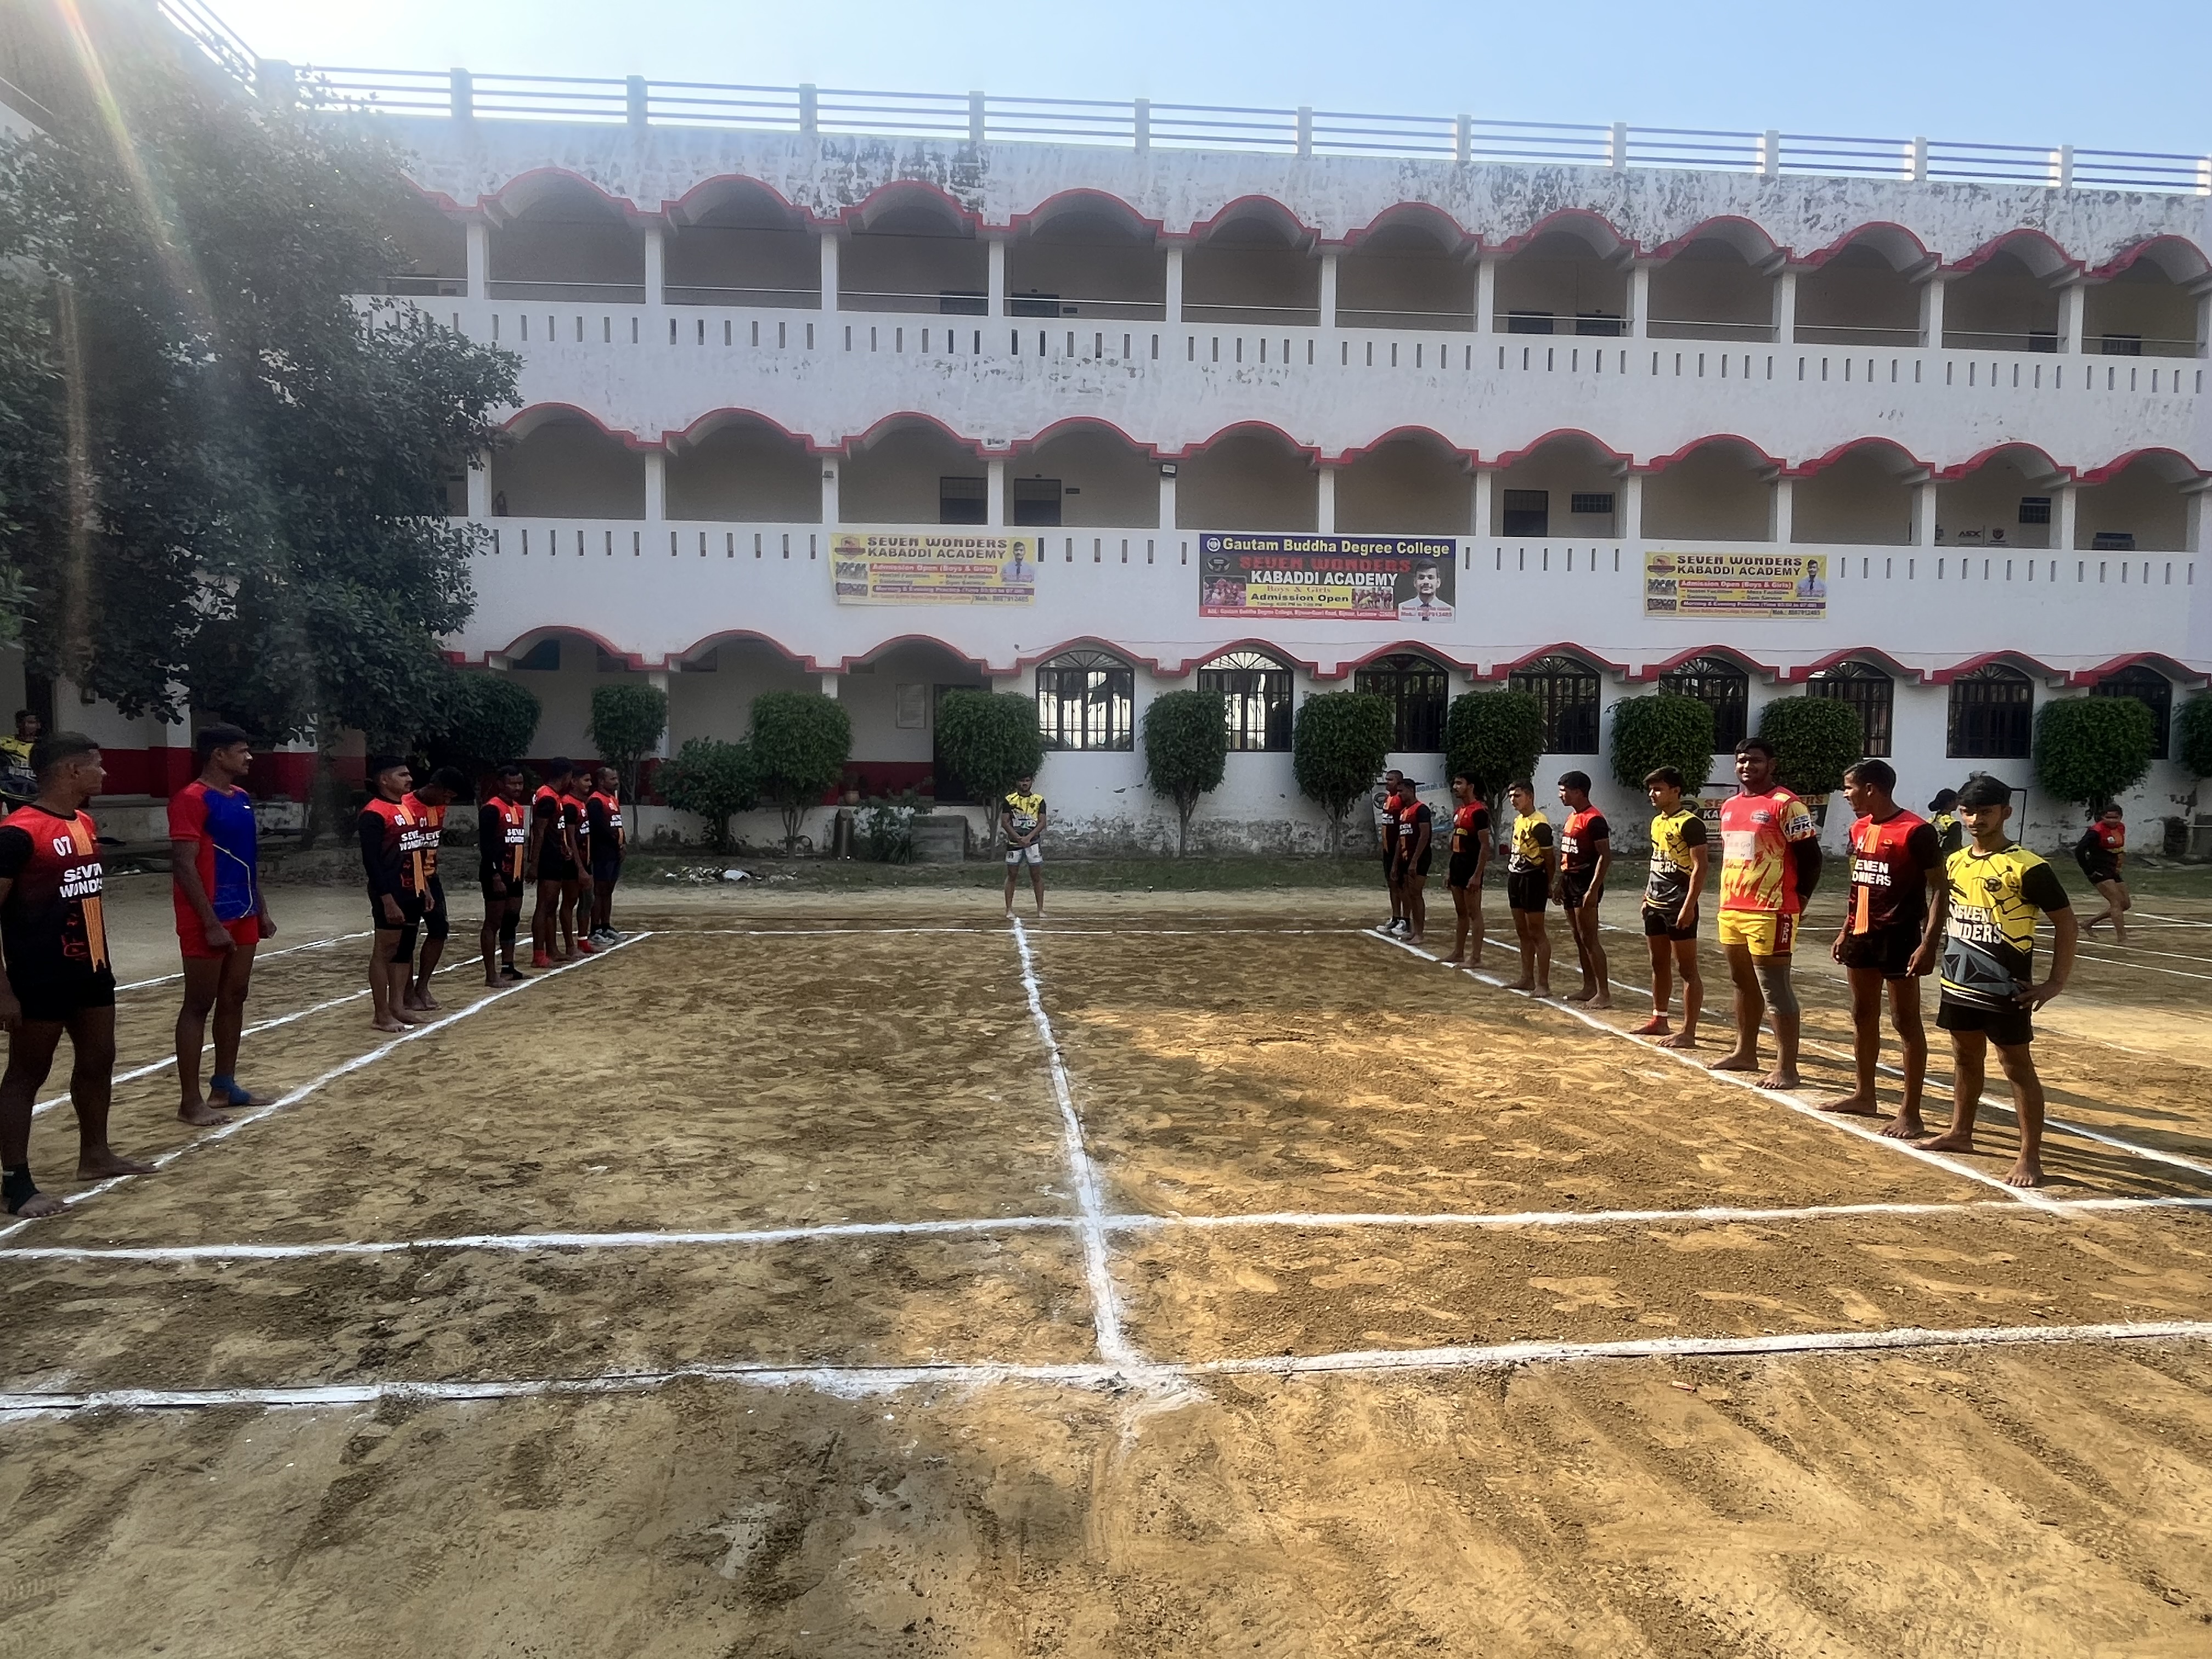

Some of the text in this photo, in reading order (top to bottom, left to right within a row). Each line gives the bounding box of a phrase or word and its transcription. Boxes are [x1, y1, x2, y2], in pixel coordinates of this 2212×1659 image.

[867, 537, 1007, 549] SEVEN WONDERS
[1223, 538, 1449, 557] Gautam Buddha Degree College
[868, 548, 932, 557] KABADDI
[936, 549, 1006, 559] ACADEMY
[1239, 556, 1411, 572] SEVEN WONDERS
[1677, 556, 1802, 566] SEVEN WONDERS
[1678, 566, 1734, 574] KABADDI
[1739, 567, 1801, 575] ACADEMY
[1251, 571, 1398, 586] KABADDI ACADEMY
[1251, 593, 1348, 603] Admission Open
[53, 836, 72, 856] 07
